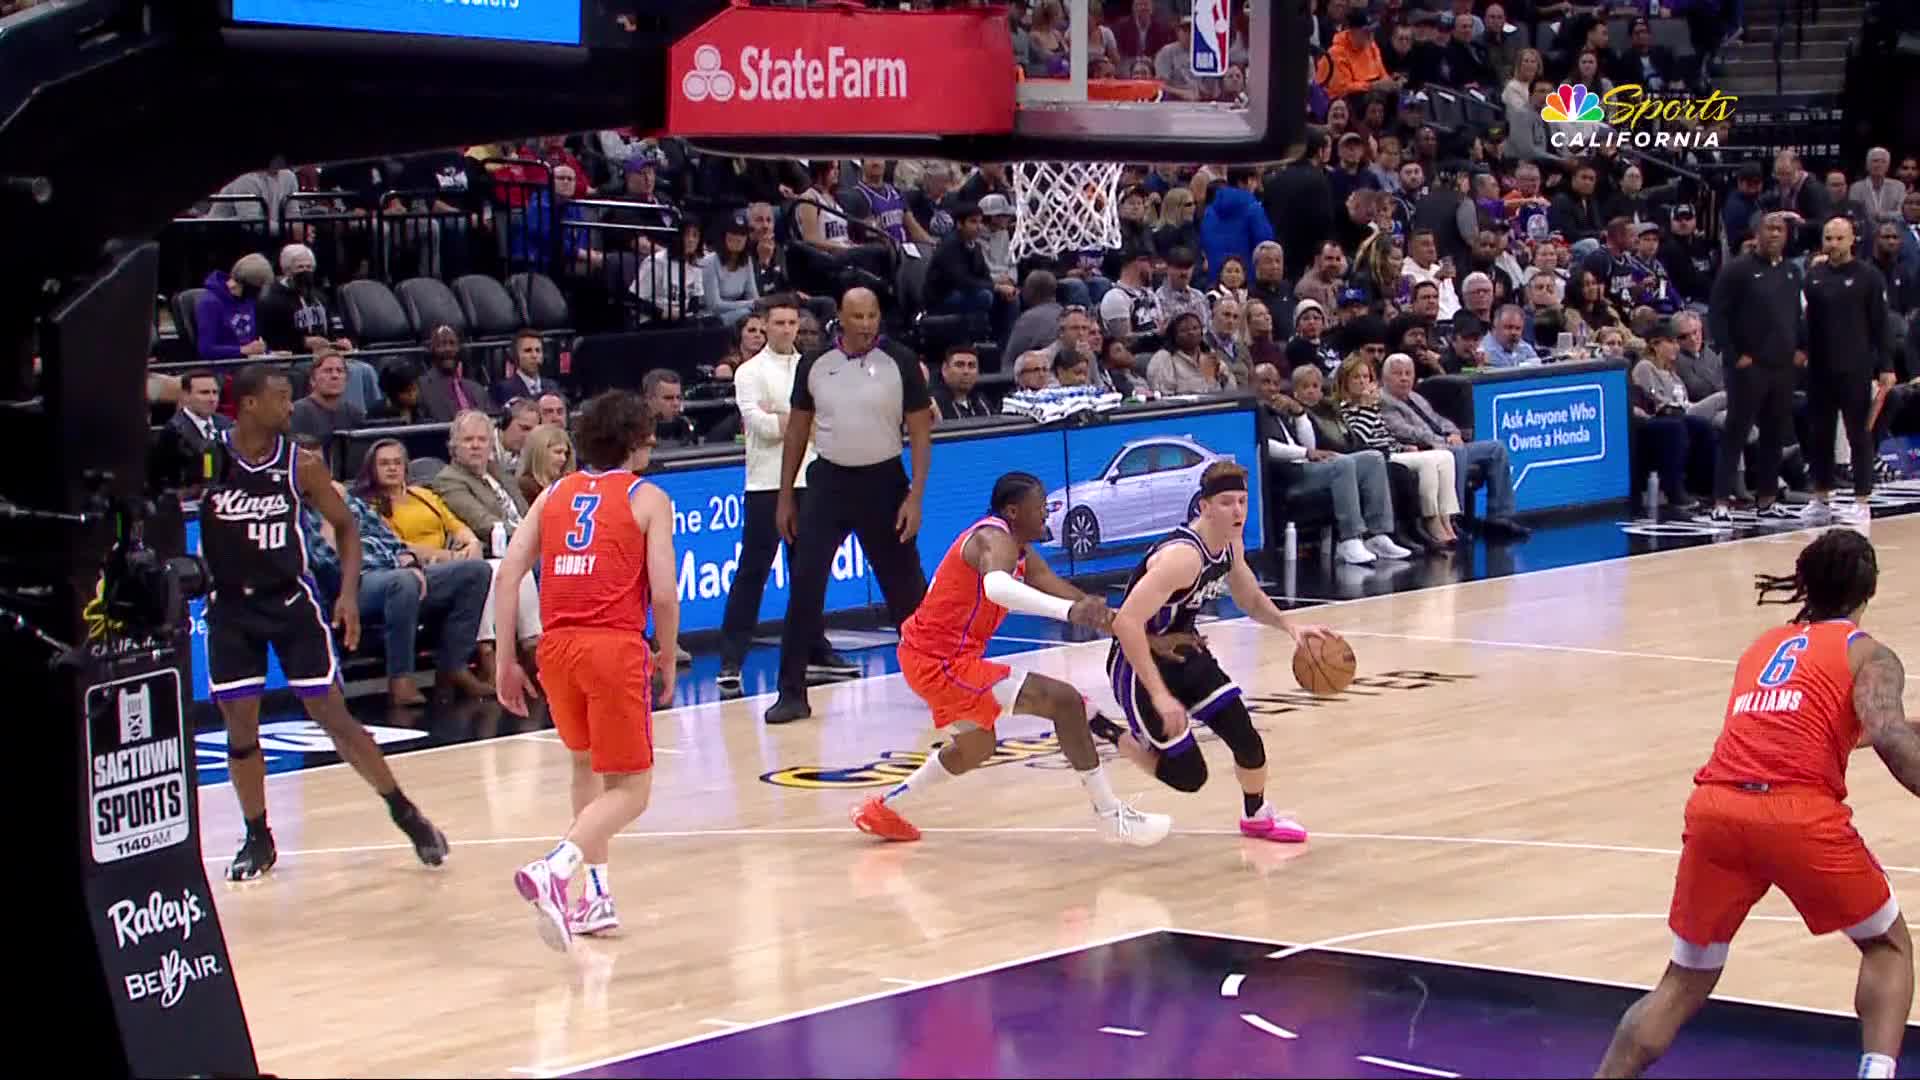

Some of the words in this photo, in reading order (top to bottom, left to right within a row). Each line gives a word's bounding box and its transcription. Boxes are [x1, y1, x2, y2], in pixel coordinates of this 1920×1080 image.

[1502, 410, 1523, 430] Ask
[1525, 408, 1568, 429] Anyone
[1569, 401, 1597, 421] Who
[1509, 433, 1542, 452] Owns
[1544, 434, 1552, 447] a
[1552, 424, 1590, 446] Honda
[211, 489, 290, 520] Kings
[671, 500, 702, 535] he
[247, 521, 287, 550] 40
[565, 492, 601, 551] 3
[554, 553, 597, 576] GIDDEY
[1757, 634, 1809, 687] 6
[1732, 689, 1803, 716] WILLIAMS
[94, 737, 180, 788] SACTOWN
[98, 779, 182, 836] SPORTS
[107, 888, 202, 948] Raley's
